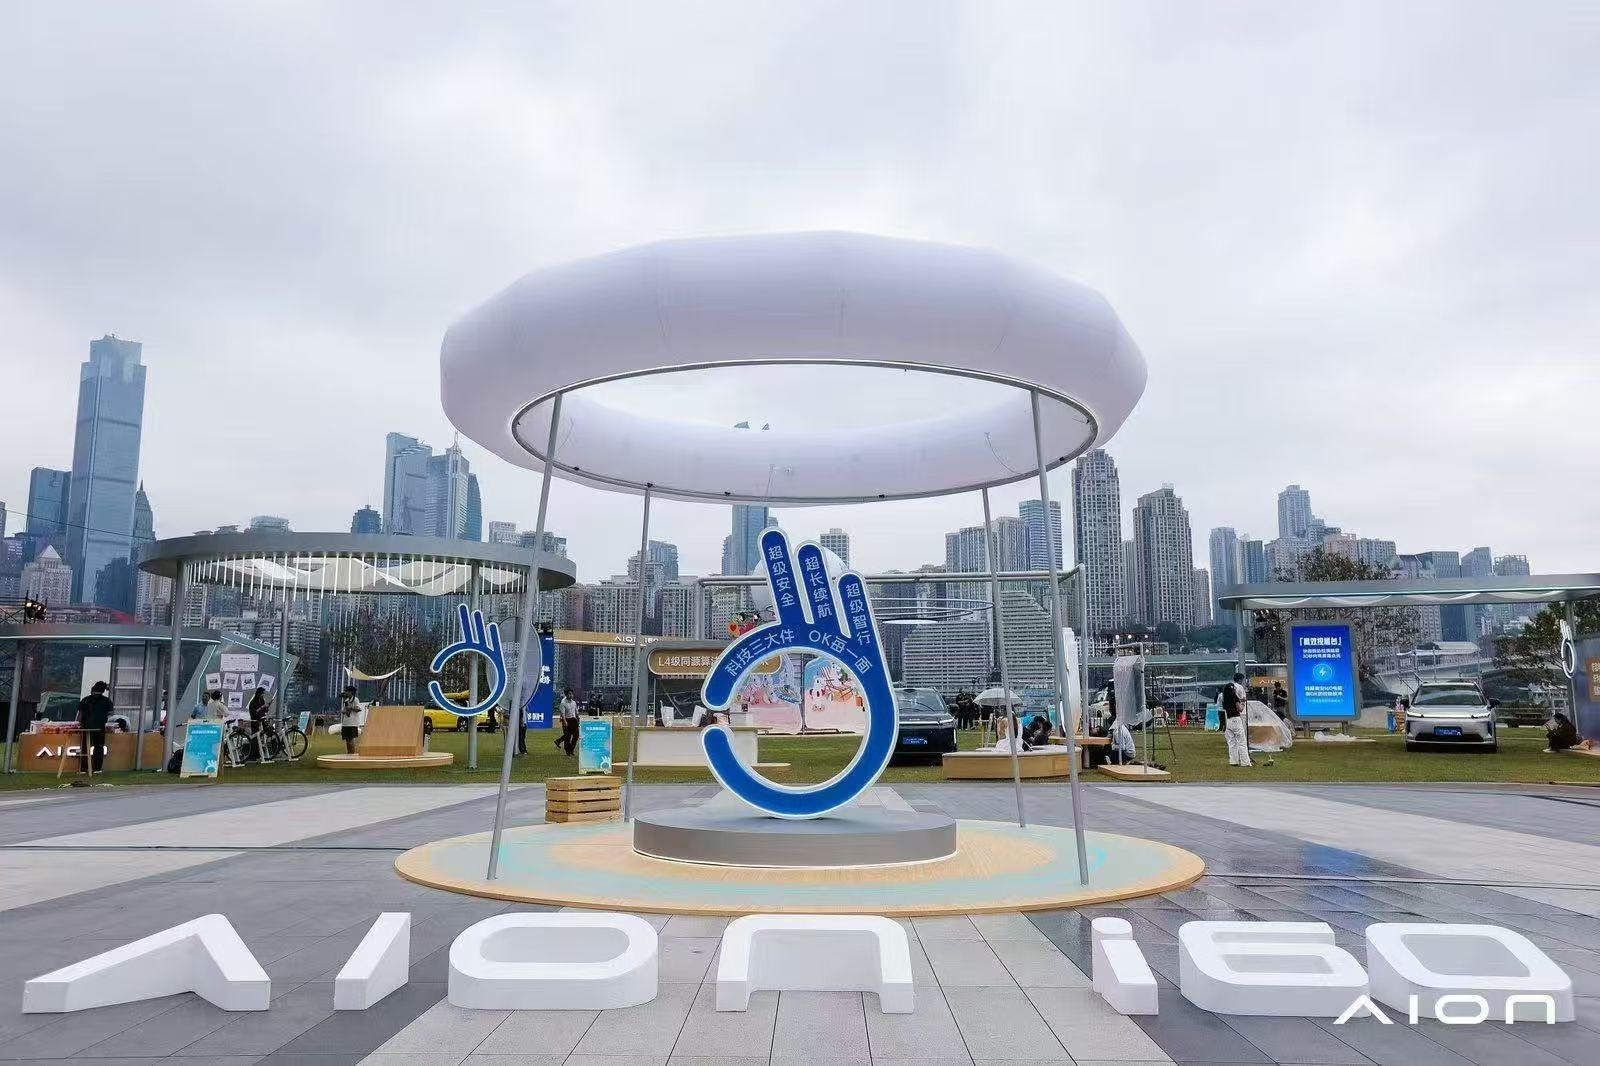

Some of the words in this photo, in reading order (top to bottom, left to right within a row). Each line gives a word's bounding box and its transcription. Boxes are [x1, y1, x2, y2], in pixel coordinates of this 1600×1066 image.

[768, 546, 795, 607] 超级安全
[804, 556, 833, 619] 超长续航
[845, 583, 871, 646] 超级智行
[724, 628, 795, 677] 科技三大件
[808, 629, 873, 675] OK每一面
[22, 911, 915, 1014] AION
[1091, 916, 1577, 1023] i60
